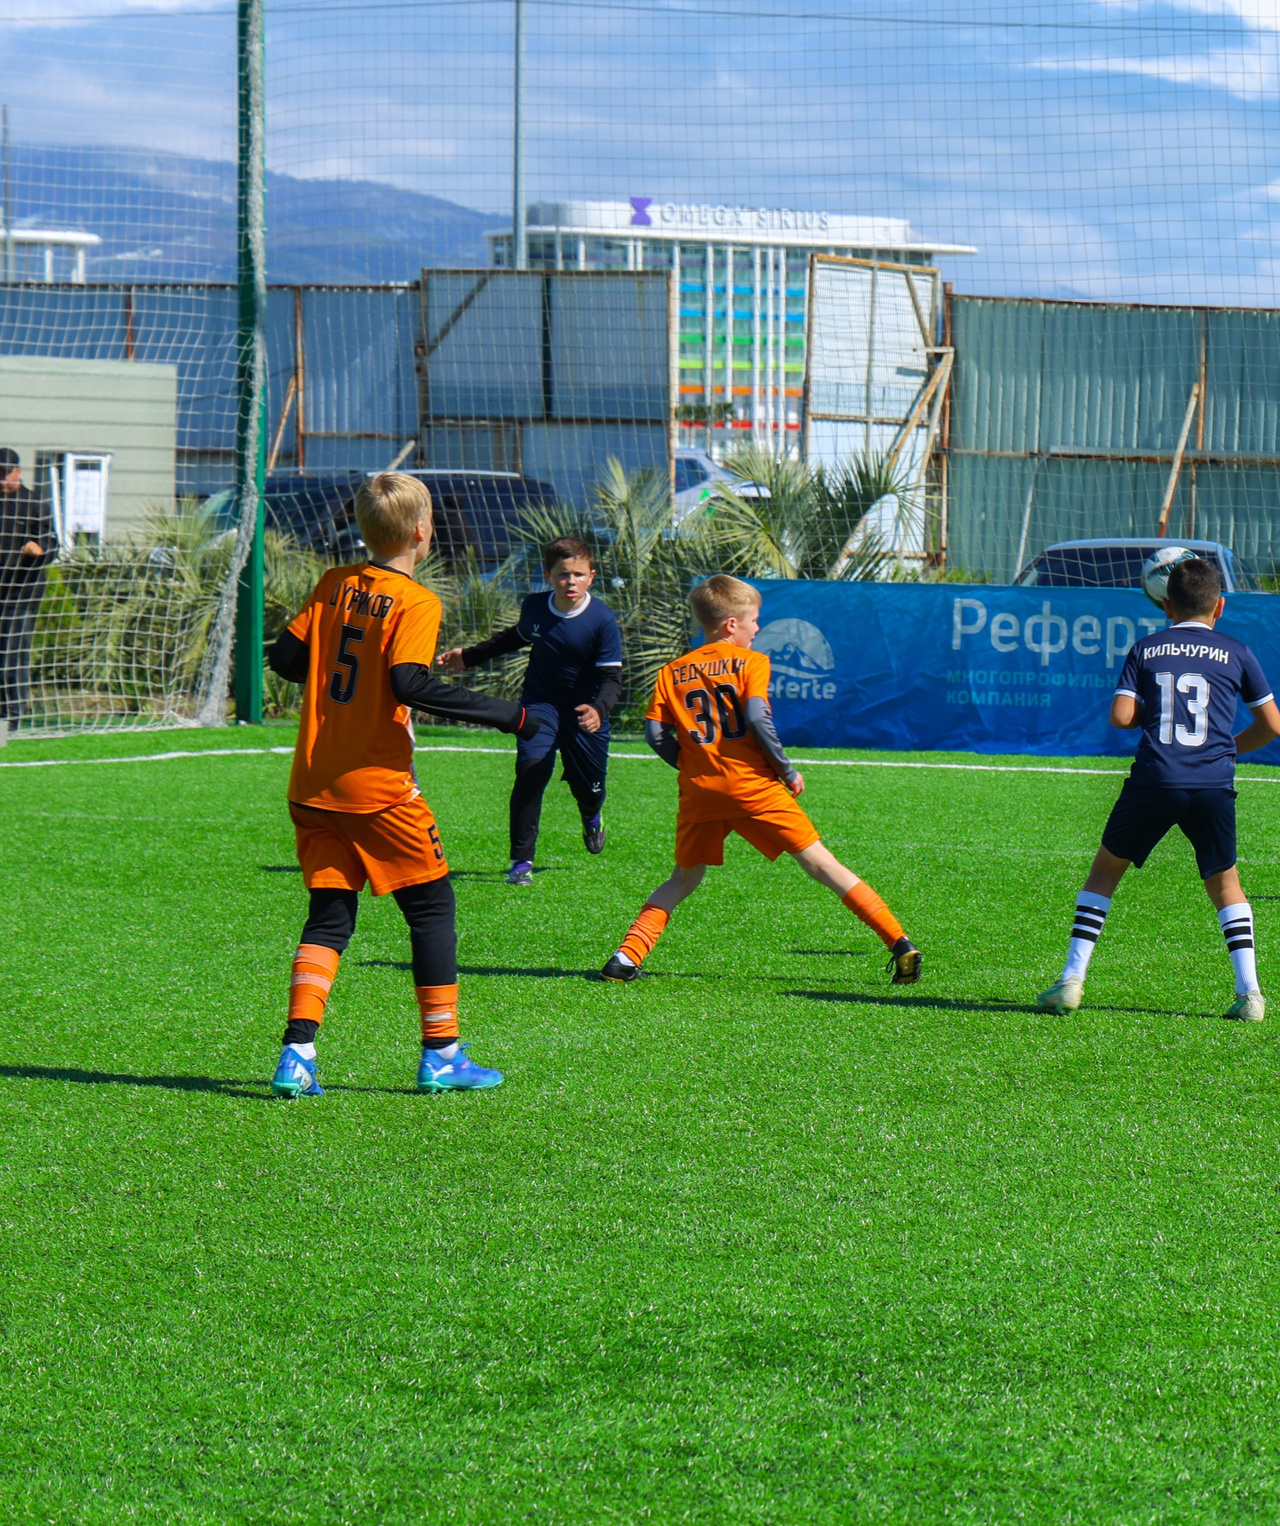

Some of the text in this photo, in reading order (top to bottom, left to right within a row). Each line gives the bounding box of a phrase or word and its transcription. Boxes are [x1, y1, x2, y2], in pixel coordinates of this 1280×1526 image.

[661, 202, 829, 231] OMEGA SIRIUS
[951, 597, 1167, 669] Реферт
[328, 623, 365, 705] 5
[1143, 642, 1230, 665] КИЛЬЧУРИН
[767, 675, 837, 700] eferte
[946, 669, 1119, 689] МНОГОПРОФИЛЬН
[946, 690, 1051, 707] КОМПАНИЯ
[1155, 671, 1211, 747] 13
[684, 682, 748, 745] 30
